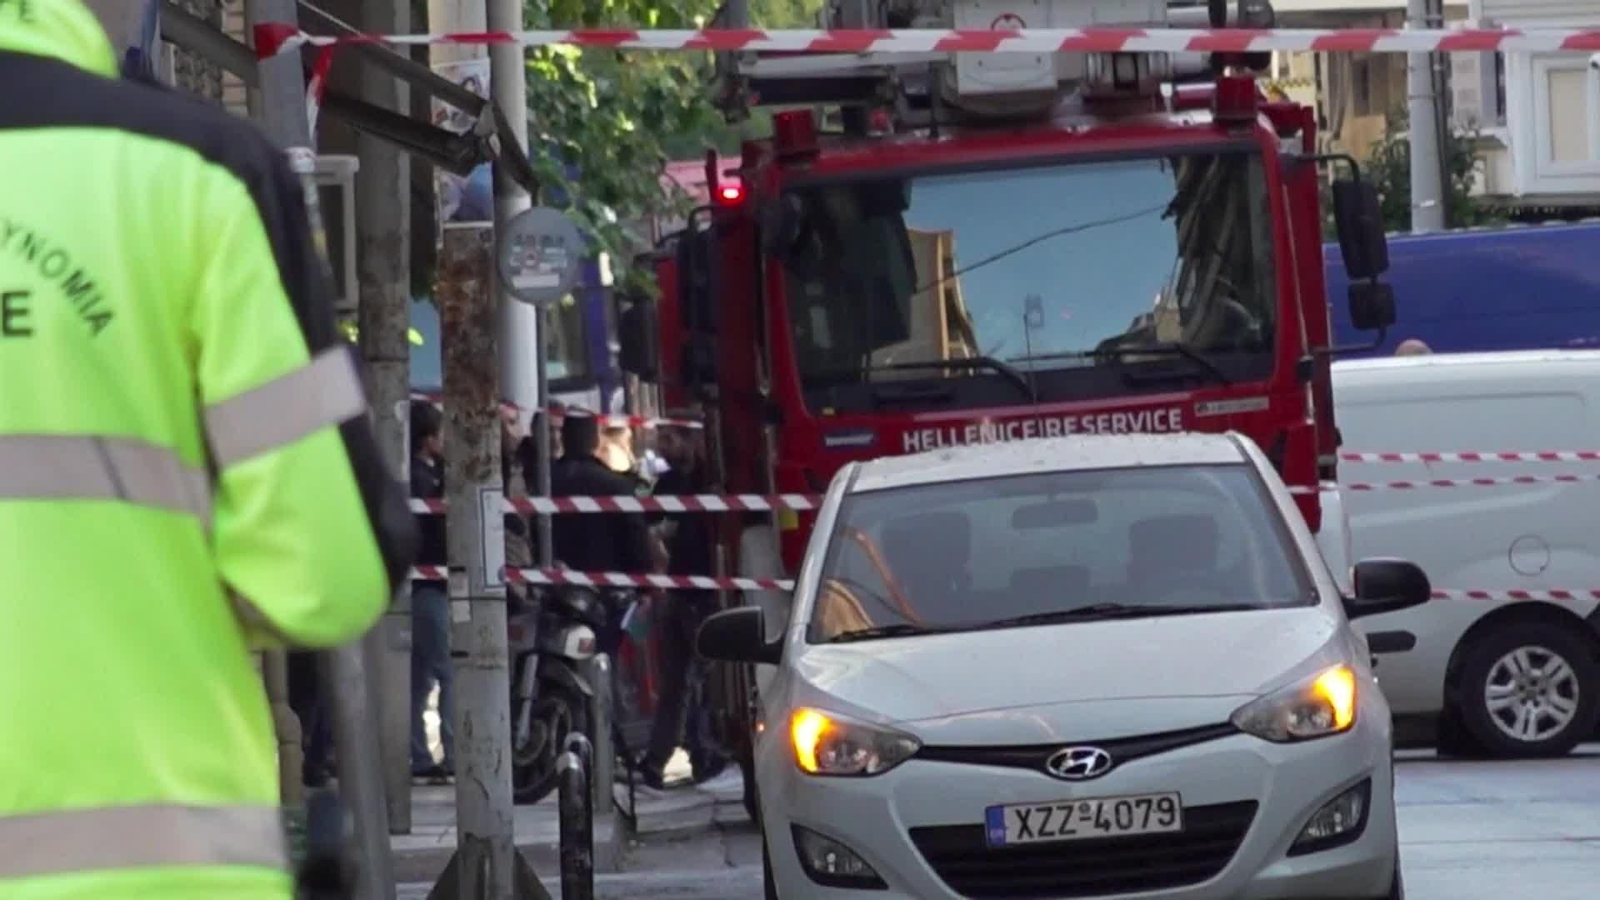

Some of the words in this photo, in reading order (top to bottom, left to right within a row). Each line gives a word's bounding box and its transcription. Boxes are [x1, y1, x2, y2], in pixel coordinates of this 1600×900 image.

[902, 420, 1021, 453] HELLENIC
[1081, 408, 1183, 436] SERVICE
[1015, 796, 1176, 840] XZZ-4079
